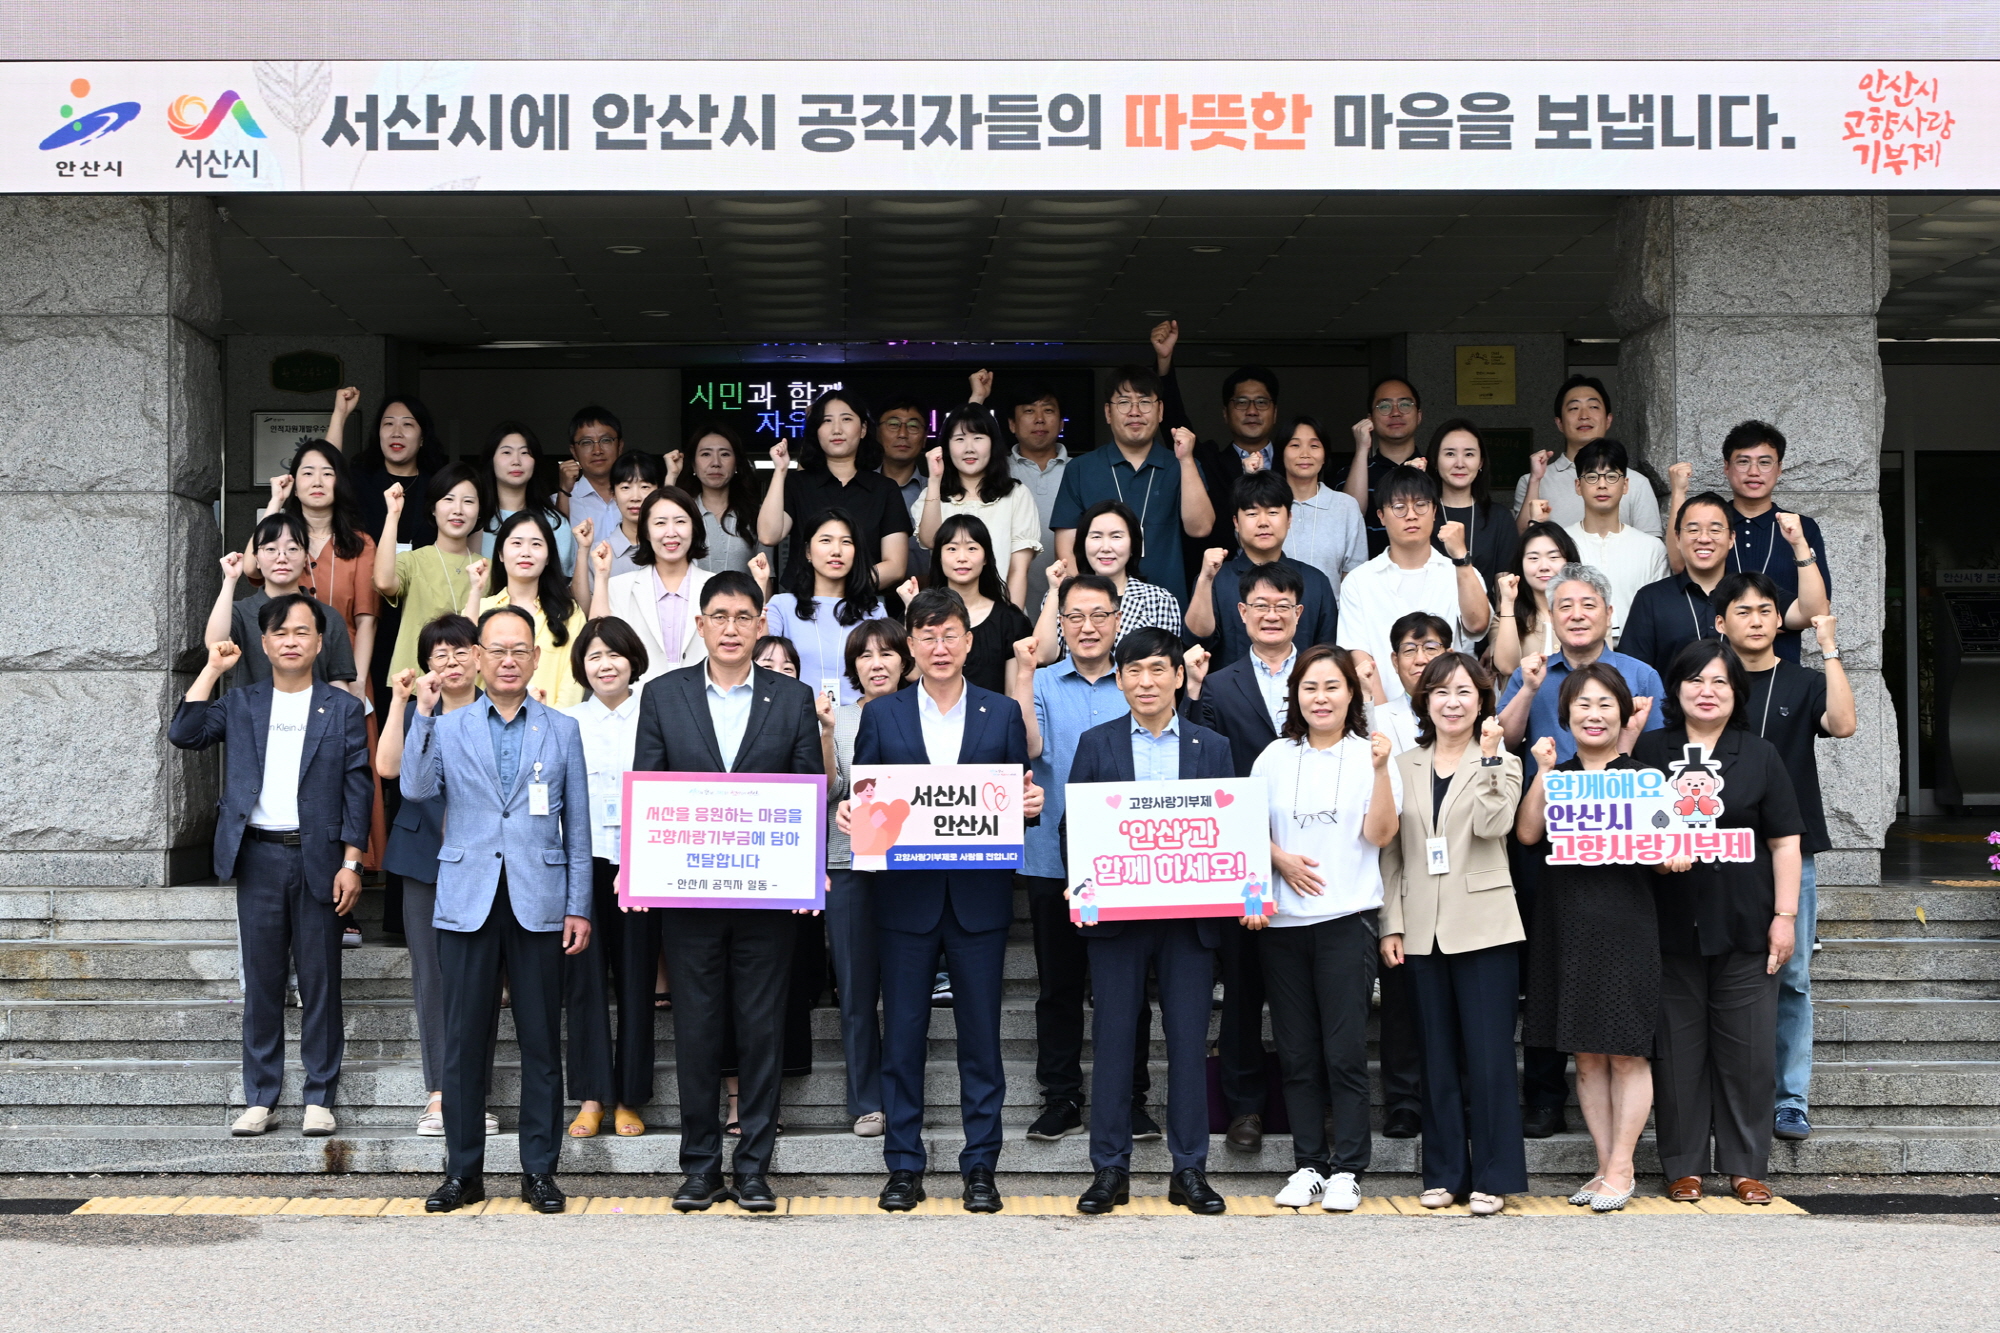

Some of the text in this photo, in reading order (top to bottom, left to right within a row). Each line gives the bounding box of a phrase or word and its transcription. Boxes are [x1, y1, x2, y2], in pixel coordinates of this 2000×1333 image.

[1858, 69, 1939, 107] 안산시
[321, 92, 1796, 152] 서산시에 안산시 공직자들의 따뜻한 마음을 보냅니다.
[1842, 106, 1956, 141] 고향사랑
[56, 161, 122, 177] 안산시
[175, 149, 258, 178] 서산시
[1853, 140, 1941, 176] 기부제
[689, 382, 777, 410] 시민과
[270, 425, 330, 434] 인적자원개발우수
[1943, 573, 1983, 584] 안산시청
[276, 723, 297, 732] Klein
[911, 785, 976, 807] 서산시
[1546, 772, 1664, 801] 함께해요
[1129, 795, 1212, 810] 고향사랑기부제
[647, 807, 802, 824] 서산을 응원하는 마음을
[934, 815, 998, 837] 안산시
[1547, 803, 1633, 832] 안산시
[647, 829, 800, 846] 고향사랑기부금에 담아
[1549, 832, 1752, 863] 고향사랑기부제
[687, 853, 760, 869] 전달합니다
[959, 853, 984, 861] 사랑을
[985, 853, 1018, 861] 전합니다
[1093, 851, 1246, 886] 함께 하세요!
[677, 879, 708, 890] 안산시
[712, 879, 743, 891] 공직자
[748, 880, 768, 891] 일동
